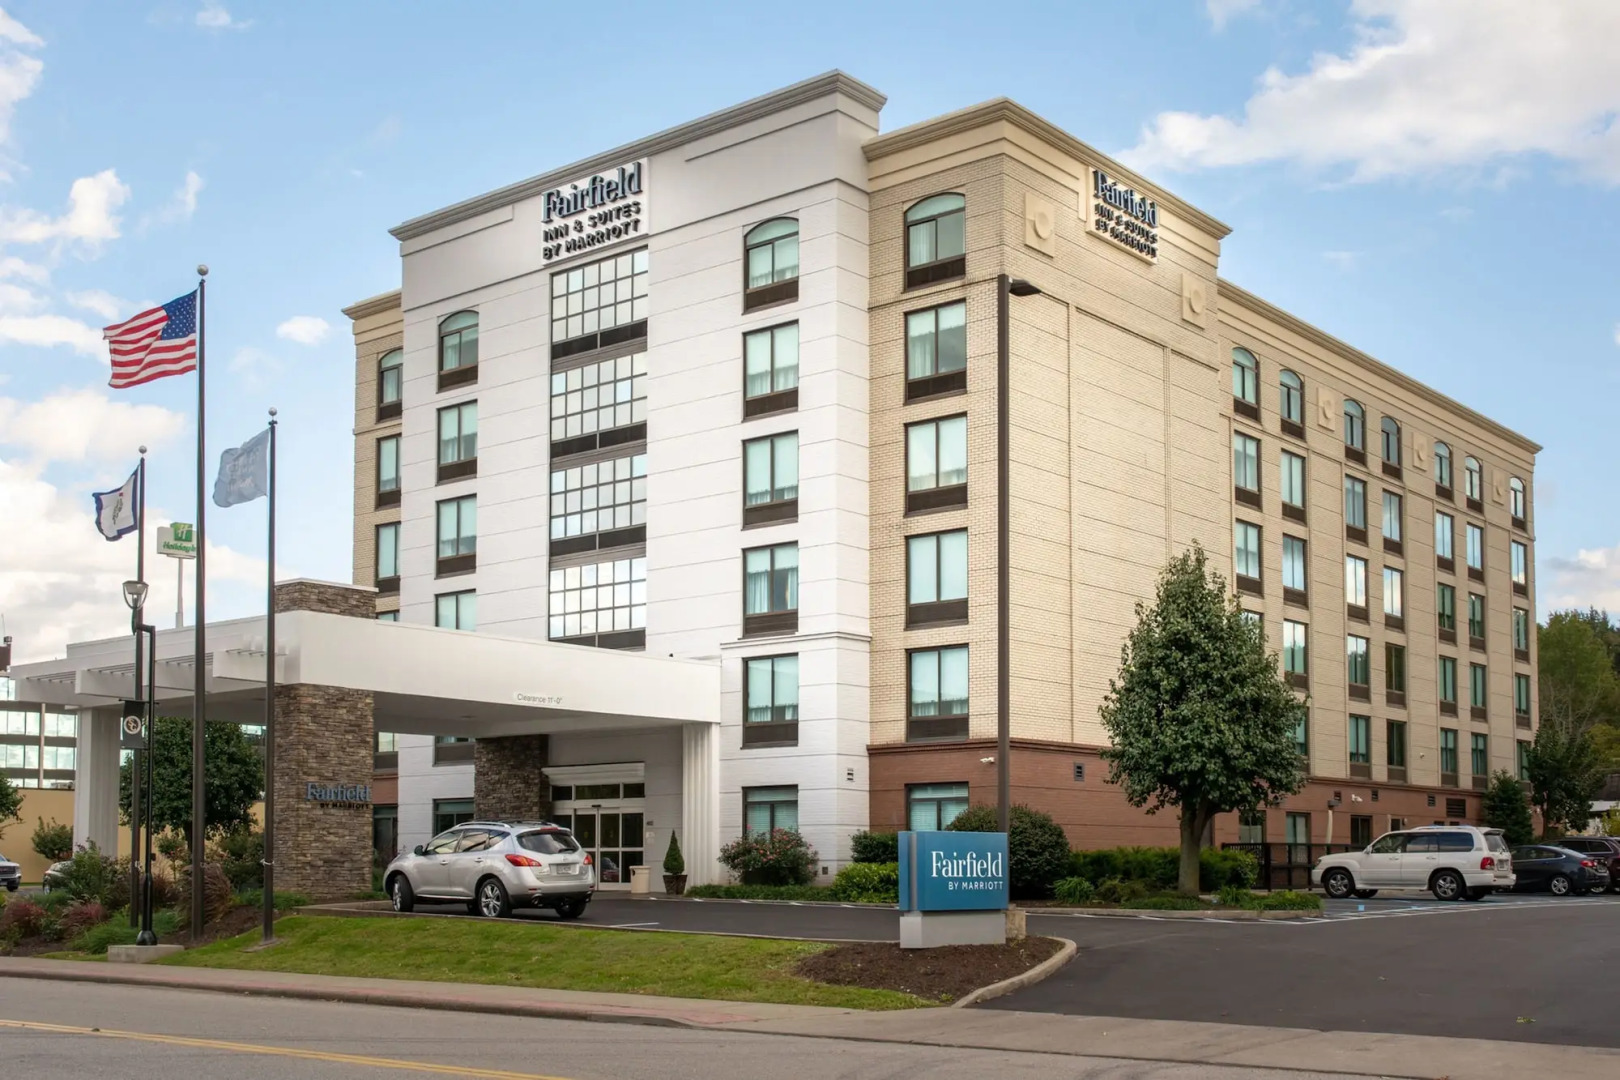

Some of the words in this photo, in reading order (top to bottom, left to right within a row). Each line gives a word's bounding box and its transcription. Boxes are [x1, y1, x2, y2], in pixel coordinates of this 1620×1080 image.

[541, 161, 643, 223] Fairfield
[1093, 169, 1159, 229] Fairfield
[543, 223, 569, 243] INN
[573, 219, 583, 233] &
[588, 200, 641, 228] SUITES
[543, 243, 562, 261] BY
[565, 218, 641, 253] MARRIOTT
[517, 693, 546, 703] Clearance
[305, 782, 371, 802] Fairfield
[931, 851, 1003, 878] Fairfield
[948, 881, 959, 891] BY
[961, 881, 1004, 890] MARRIOTT
